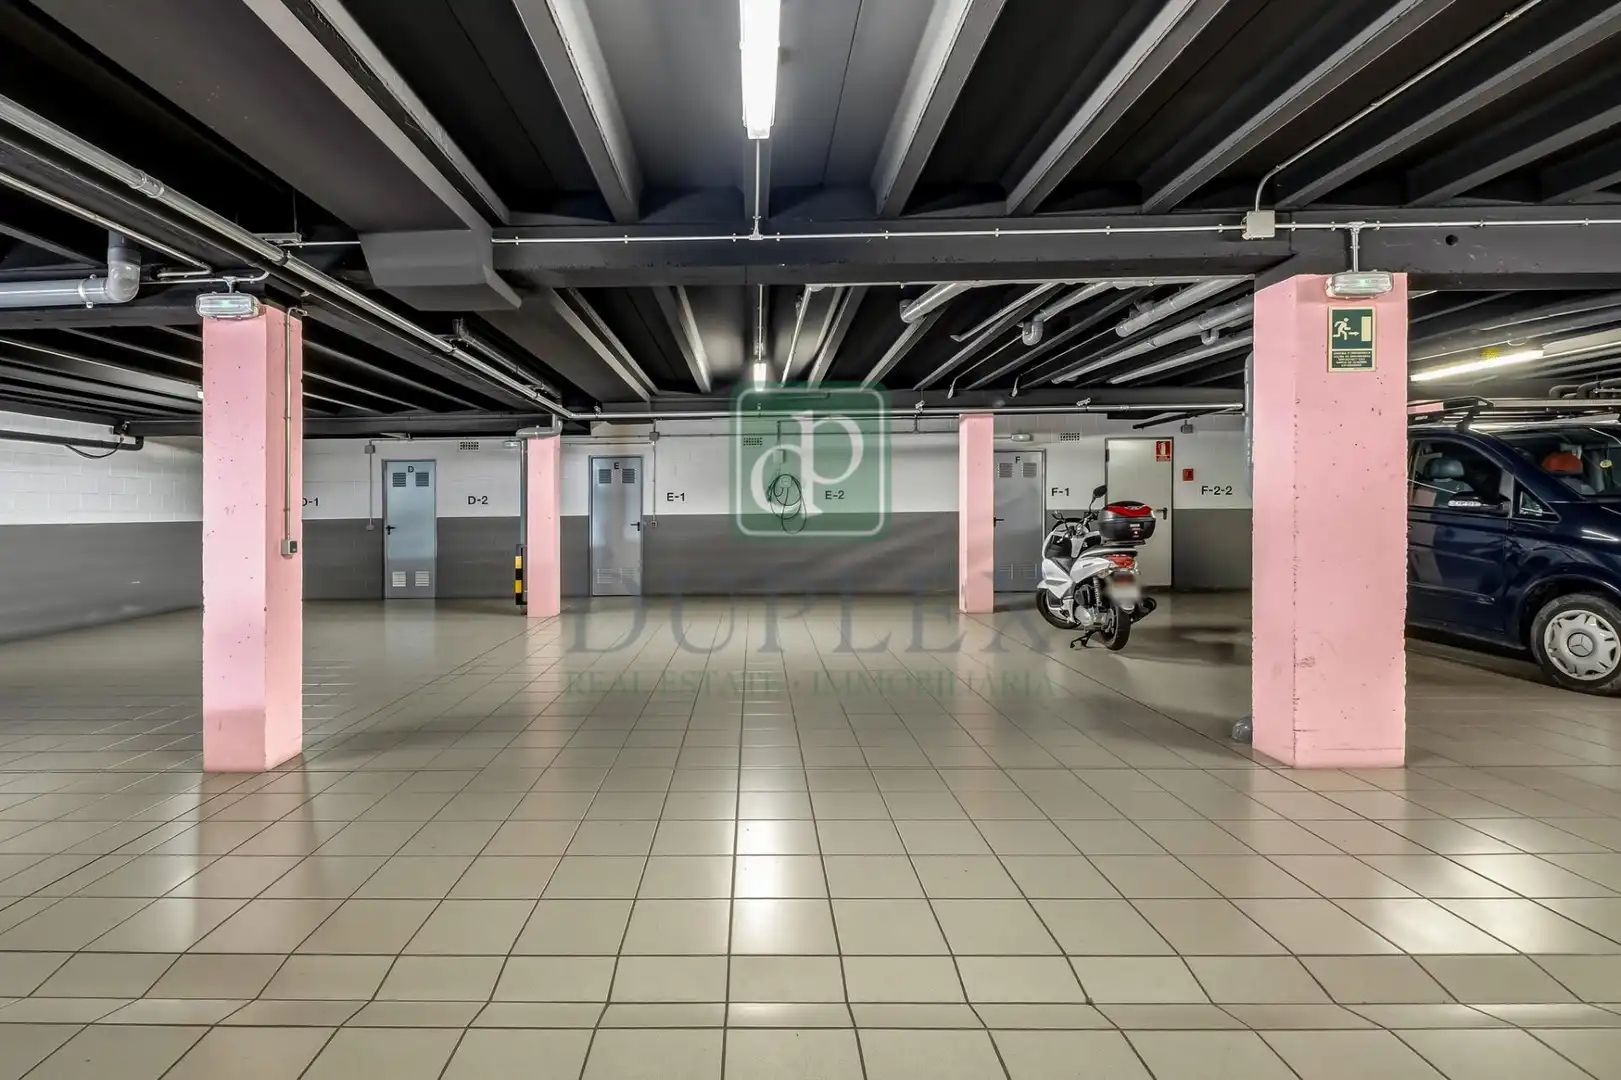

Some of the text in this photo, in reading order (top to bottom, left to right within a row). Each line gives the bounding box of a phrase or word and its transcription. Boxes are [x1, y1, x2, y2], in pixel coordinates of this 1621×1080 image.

[1015, 456, 1022, 464] F
[407, 465, 415, 473] D
[613, 462, 620, 470] E
[825, 490, 845, 500] E-2
[1051, 487, 1070, 497] F-1
[1201, 485, 1233, 496] F-2-2
[467, 495, 489, 505] D-2
[666, 492, 685, 502] E-1
